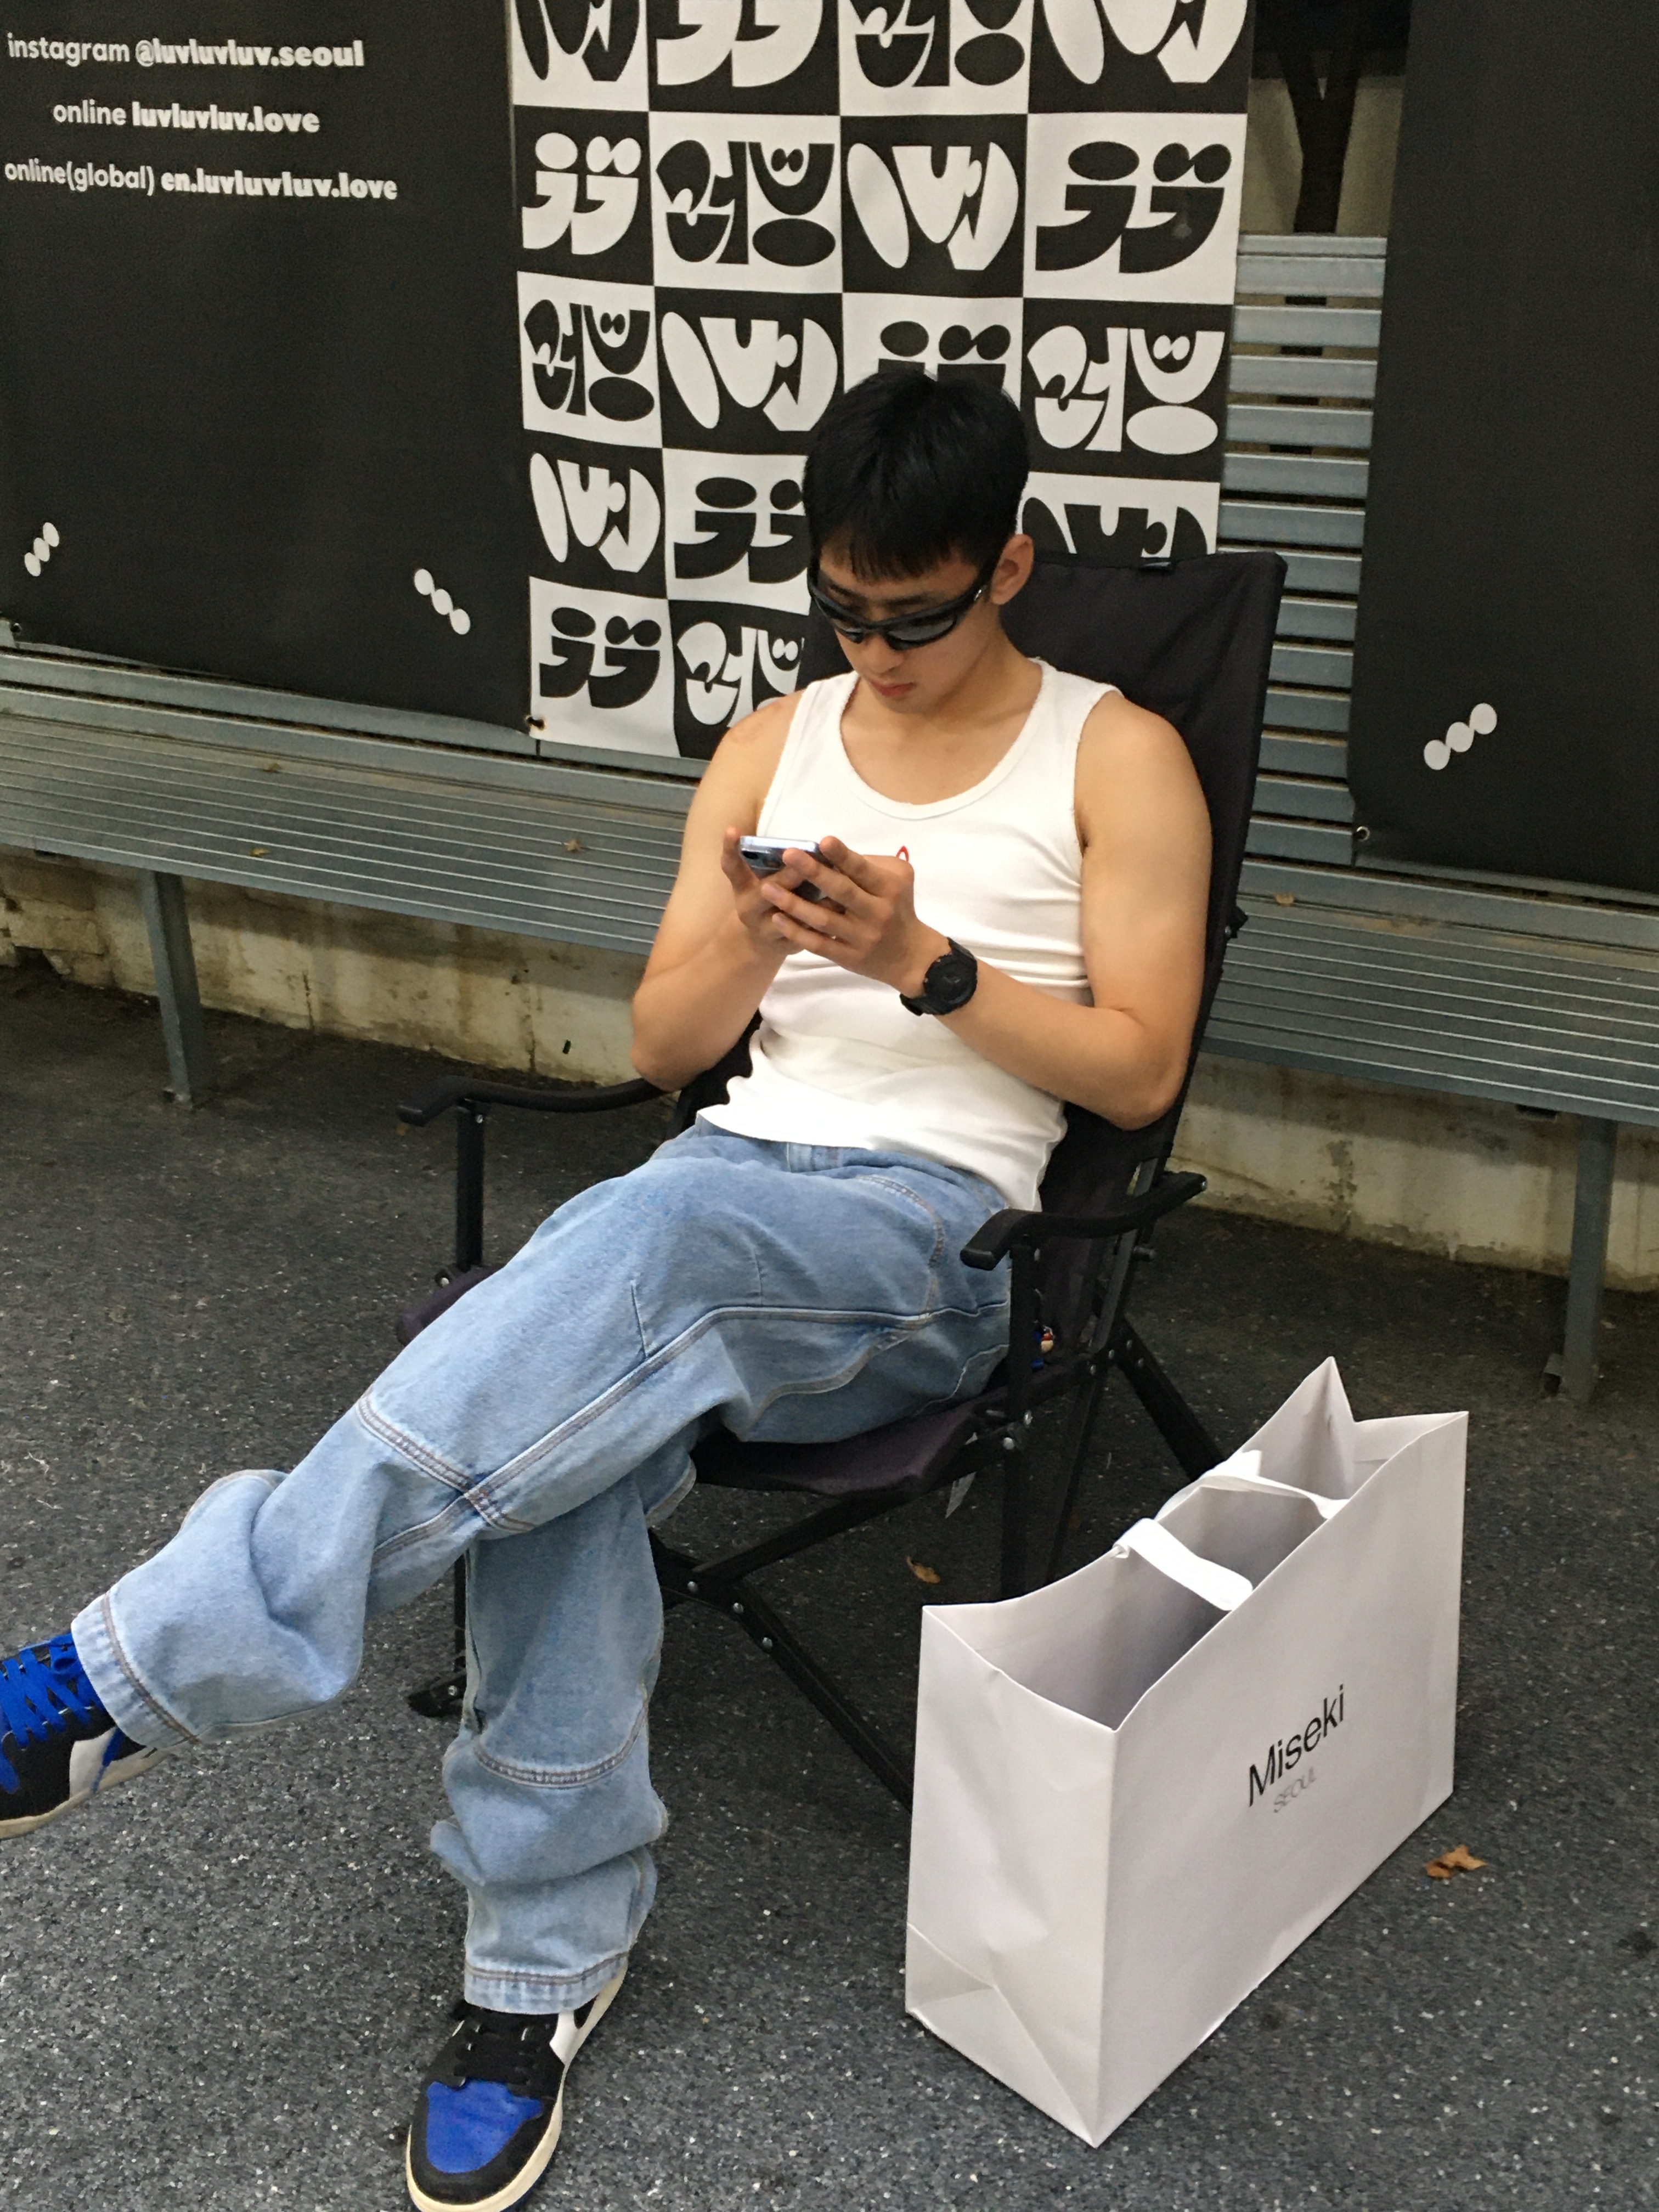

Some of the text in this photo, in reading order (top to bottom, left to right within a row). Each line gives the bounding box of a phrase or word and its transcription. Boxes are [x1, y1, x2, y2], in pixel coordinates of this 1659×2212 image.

[7, 32, 365, 67] instagram @luvluvluv.seoul
[53, 99, 320, 133] online luvluvluv.love
[4, 158, 398, 200] online(global) en.luvluvluv.love
[1249, 1684, 1344, 1807] Miseki
